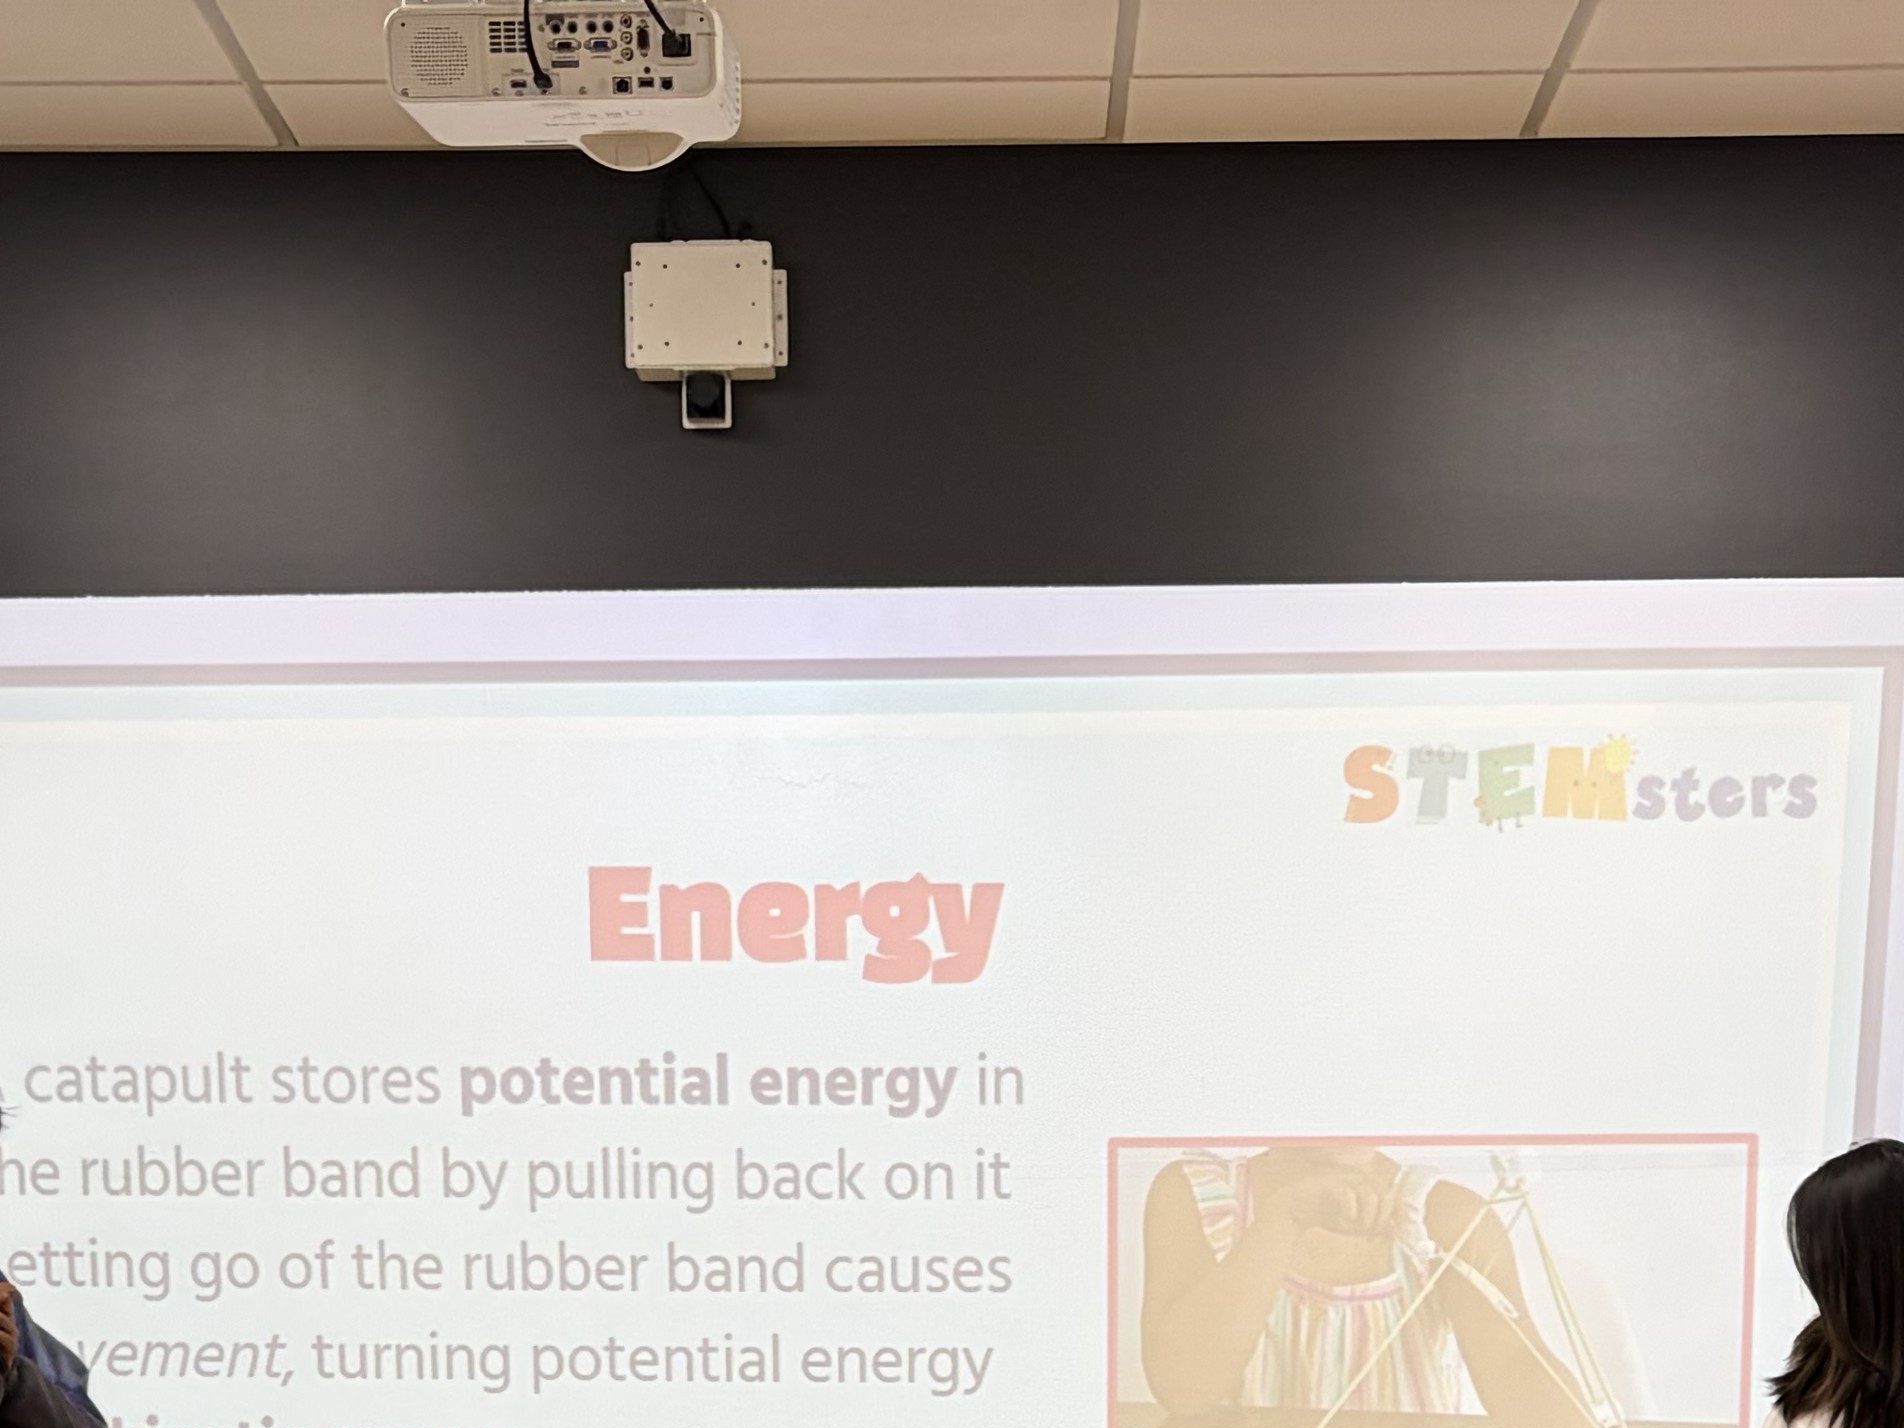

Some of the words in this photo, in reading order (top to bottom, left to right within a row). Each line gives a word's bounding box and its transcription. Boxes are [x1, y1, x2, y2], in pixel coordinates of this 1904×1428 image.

[1343, 742, 1819, 827] STEMsters
[588, 864, 1005, 985] Energy
[24, 1051, 253, 1117] catapult
[272, 1056, 441, 1104] stores
[459, 1051, 730, 1118] potential
[749, 1066, 959, 1118] energy
[977, 1051, 1025, 1107] in
[81, 1144, 265, 1197] rubber
[283, 1145, 420, 1198] band
[442, 1146, 509, 1214] by
[528, 1146, 715, 1215] pulling
[736, 1147, 867, 1200] back
[884, 1162, 954, 1201] on
[974, 1147, 1012, 1201] it
[190, 1252, 261, 1303] go
[278, 1237, 336, 1291] of
[351, 1239, 444, 1291] the
[464, 1240, 650, 1293] rubber
[667, 1241, 804, 1293] band
[825, 1256, 1012, 1294] causes
[310, 1331, 511, 1395] turning
[532, 1333, 781, 1395] potential
[801, 1347, 995, 1398] energy
